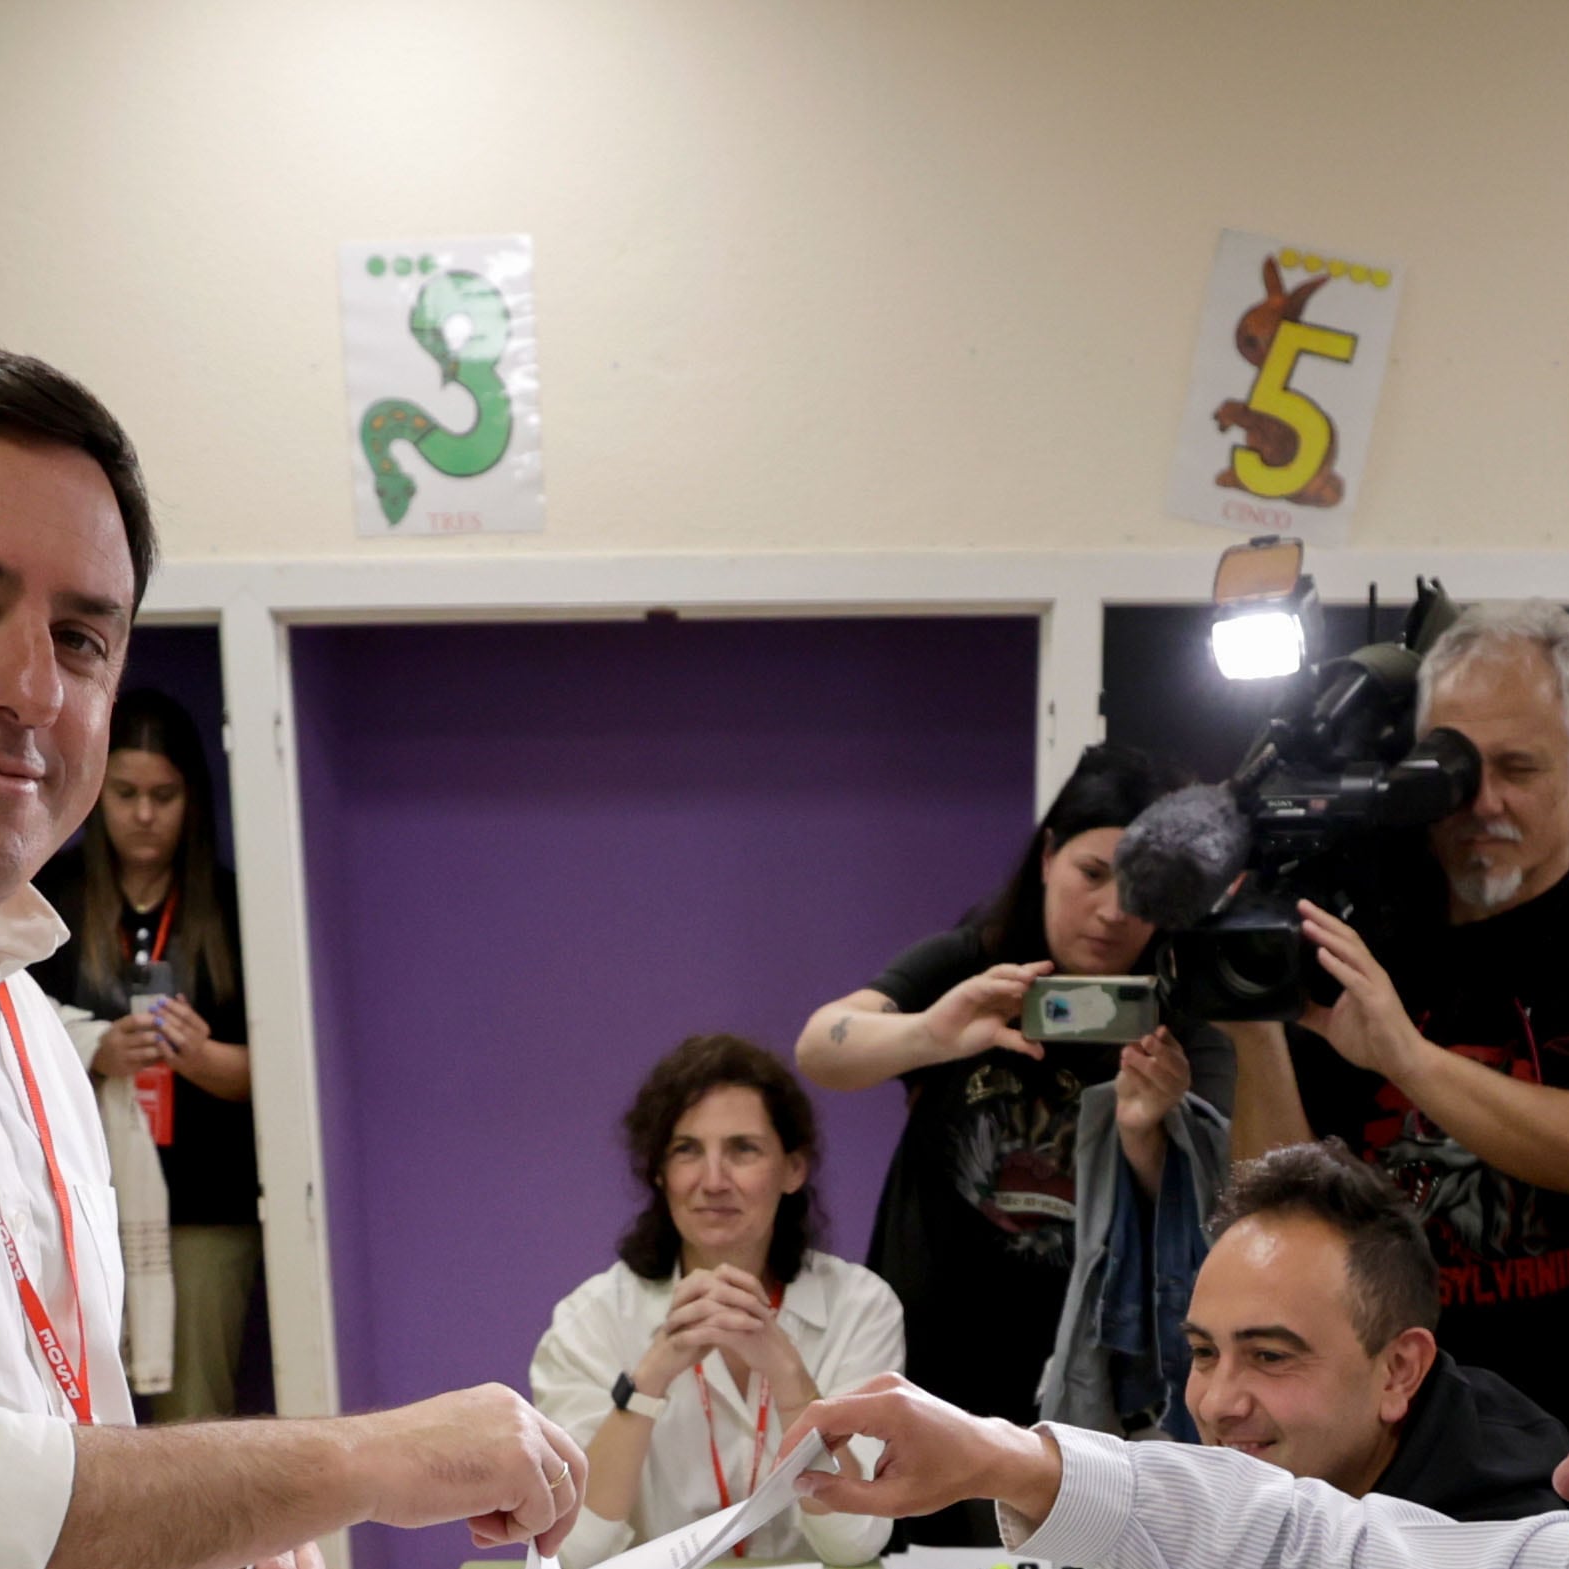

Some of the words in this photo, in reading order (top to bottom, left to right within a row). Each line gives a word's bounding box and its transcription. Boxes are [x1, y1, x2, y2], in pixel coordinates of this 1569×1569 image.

[1231, 318, 1359, 499] 5
[427, 511, 483, 530] TRES
[1222, 500, 1293, 530] CINCO
[38, 1327, 82, 1400] PSOE
